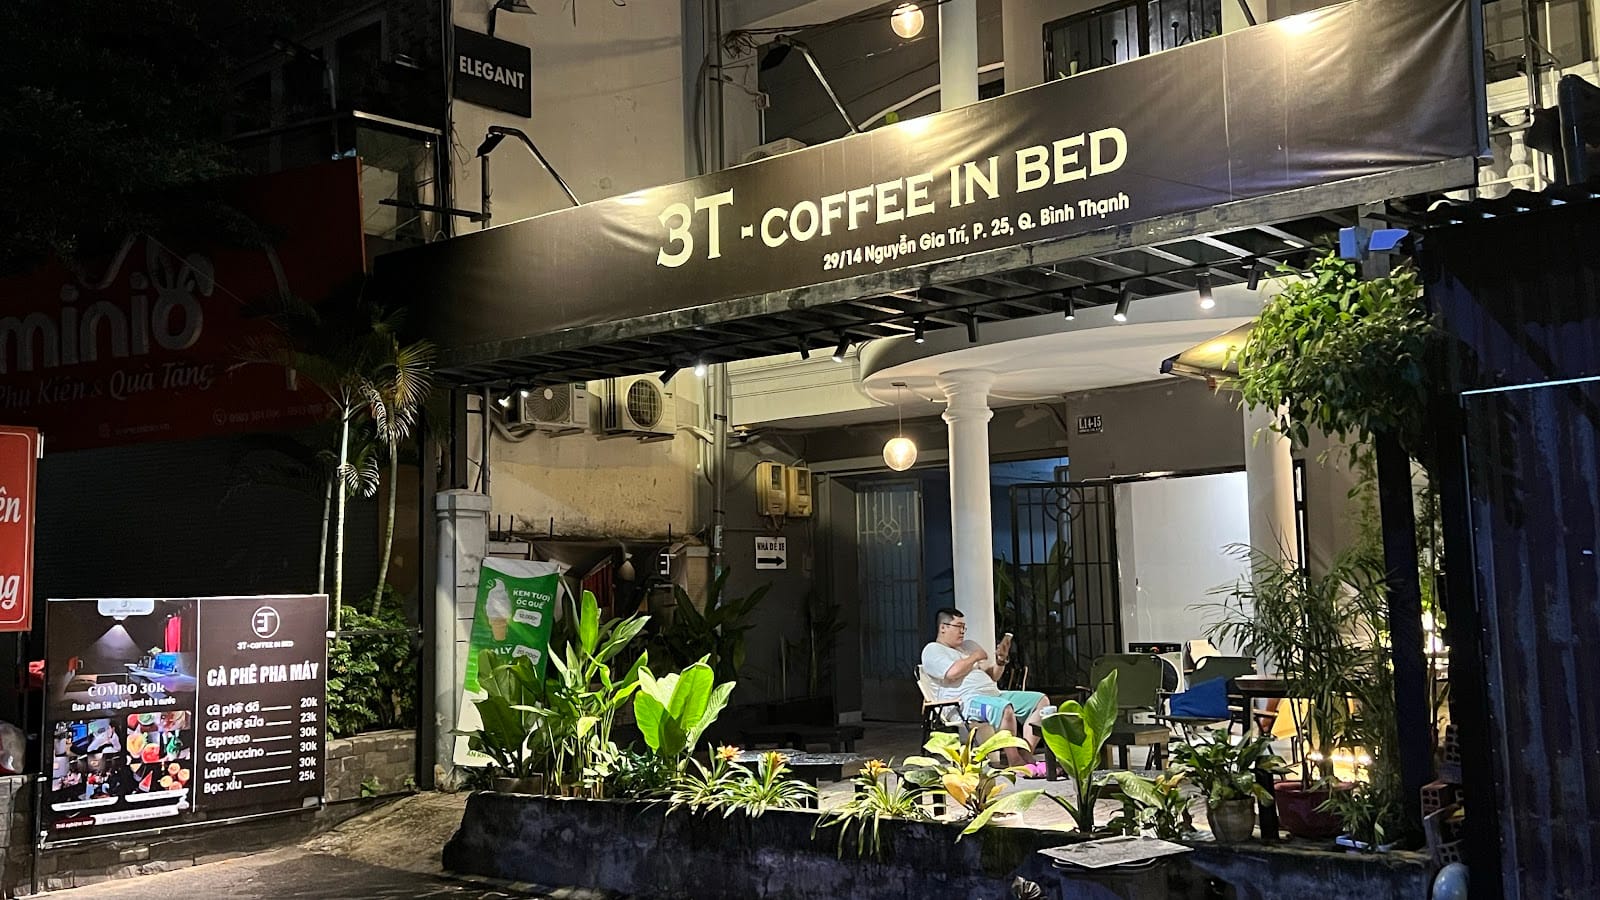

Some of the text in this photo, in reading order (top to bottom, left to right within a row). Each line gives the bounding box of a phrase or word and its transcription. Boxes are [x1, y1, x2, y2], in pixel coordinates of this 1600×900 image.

[459, 55, 525, 89] ELEGANT
[656, 188, 734, 268] 3T
[760, 173, 935, 248] COFFEE
[950, 155, 1000, 209] IN
[1015, 127, 1129, 193] BED
[823, 192, 1130, 270] 29/14 Nguyễn Gia Trí, P. 25, Q. Bình Thạnh
[109, 363, 155, 400] Quà
[160, 361, 215, 397] Tặng
[513, 590, 530, 598] KEM
[207, 660, 319, 686] CÀ PHÊ PHA MÁY
[87, 682, 165, 697] COMBO 30k
[72, 703, 85, 711] Bao
[300, 697, 318, 708] 20k
[300, 712, 317, 723] 23k
[205, 726, 317, 749] Espresso 30k
[205, 741, 317, 764] Cappuccino 30k
[204, 756, 317, 779] Latte 30k
[203, 782, 223, 795] Bạc
[298, 770, 316, 782] 25k
